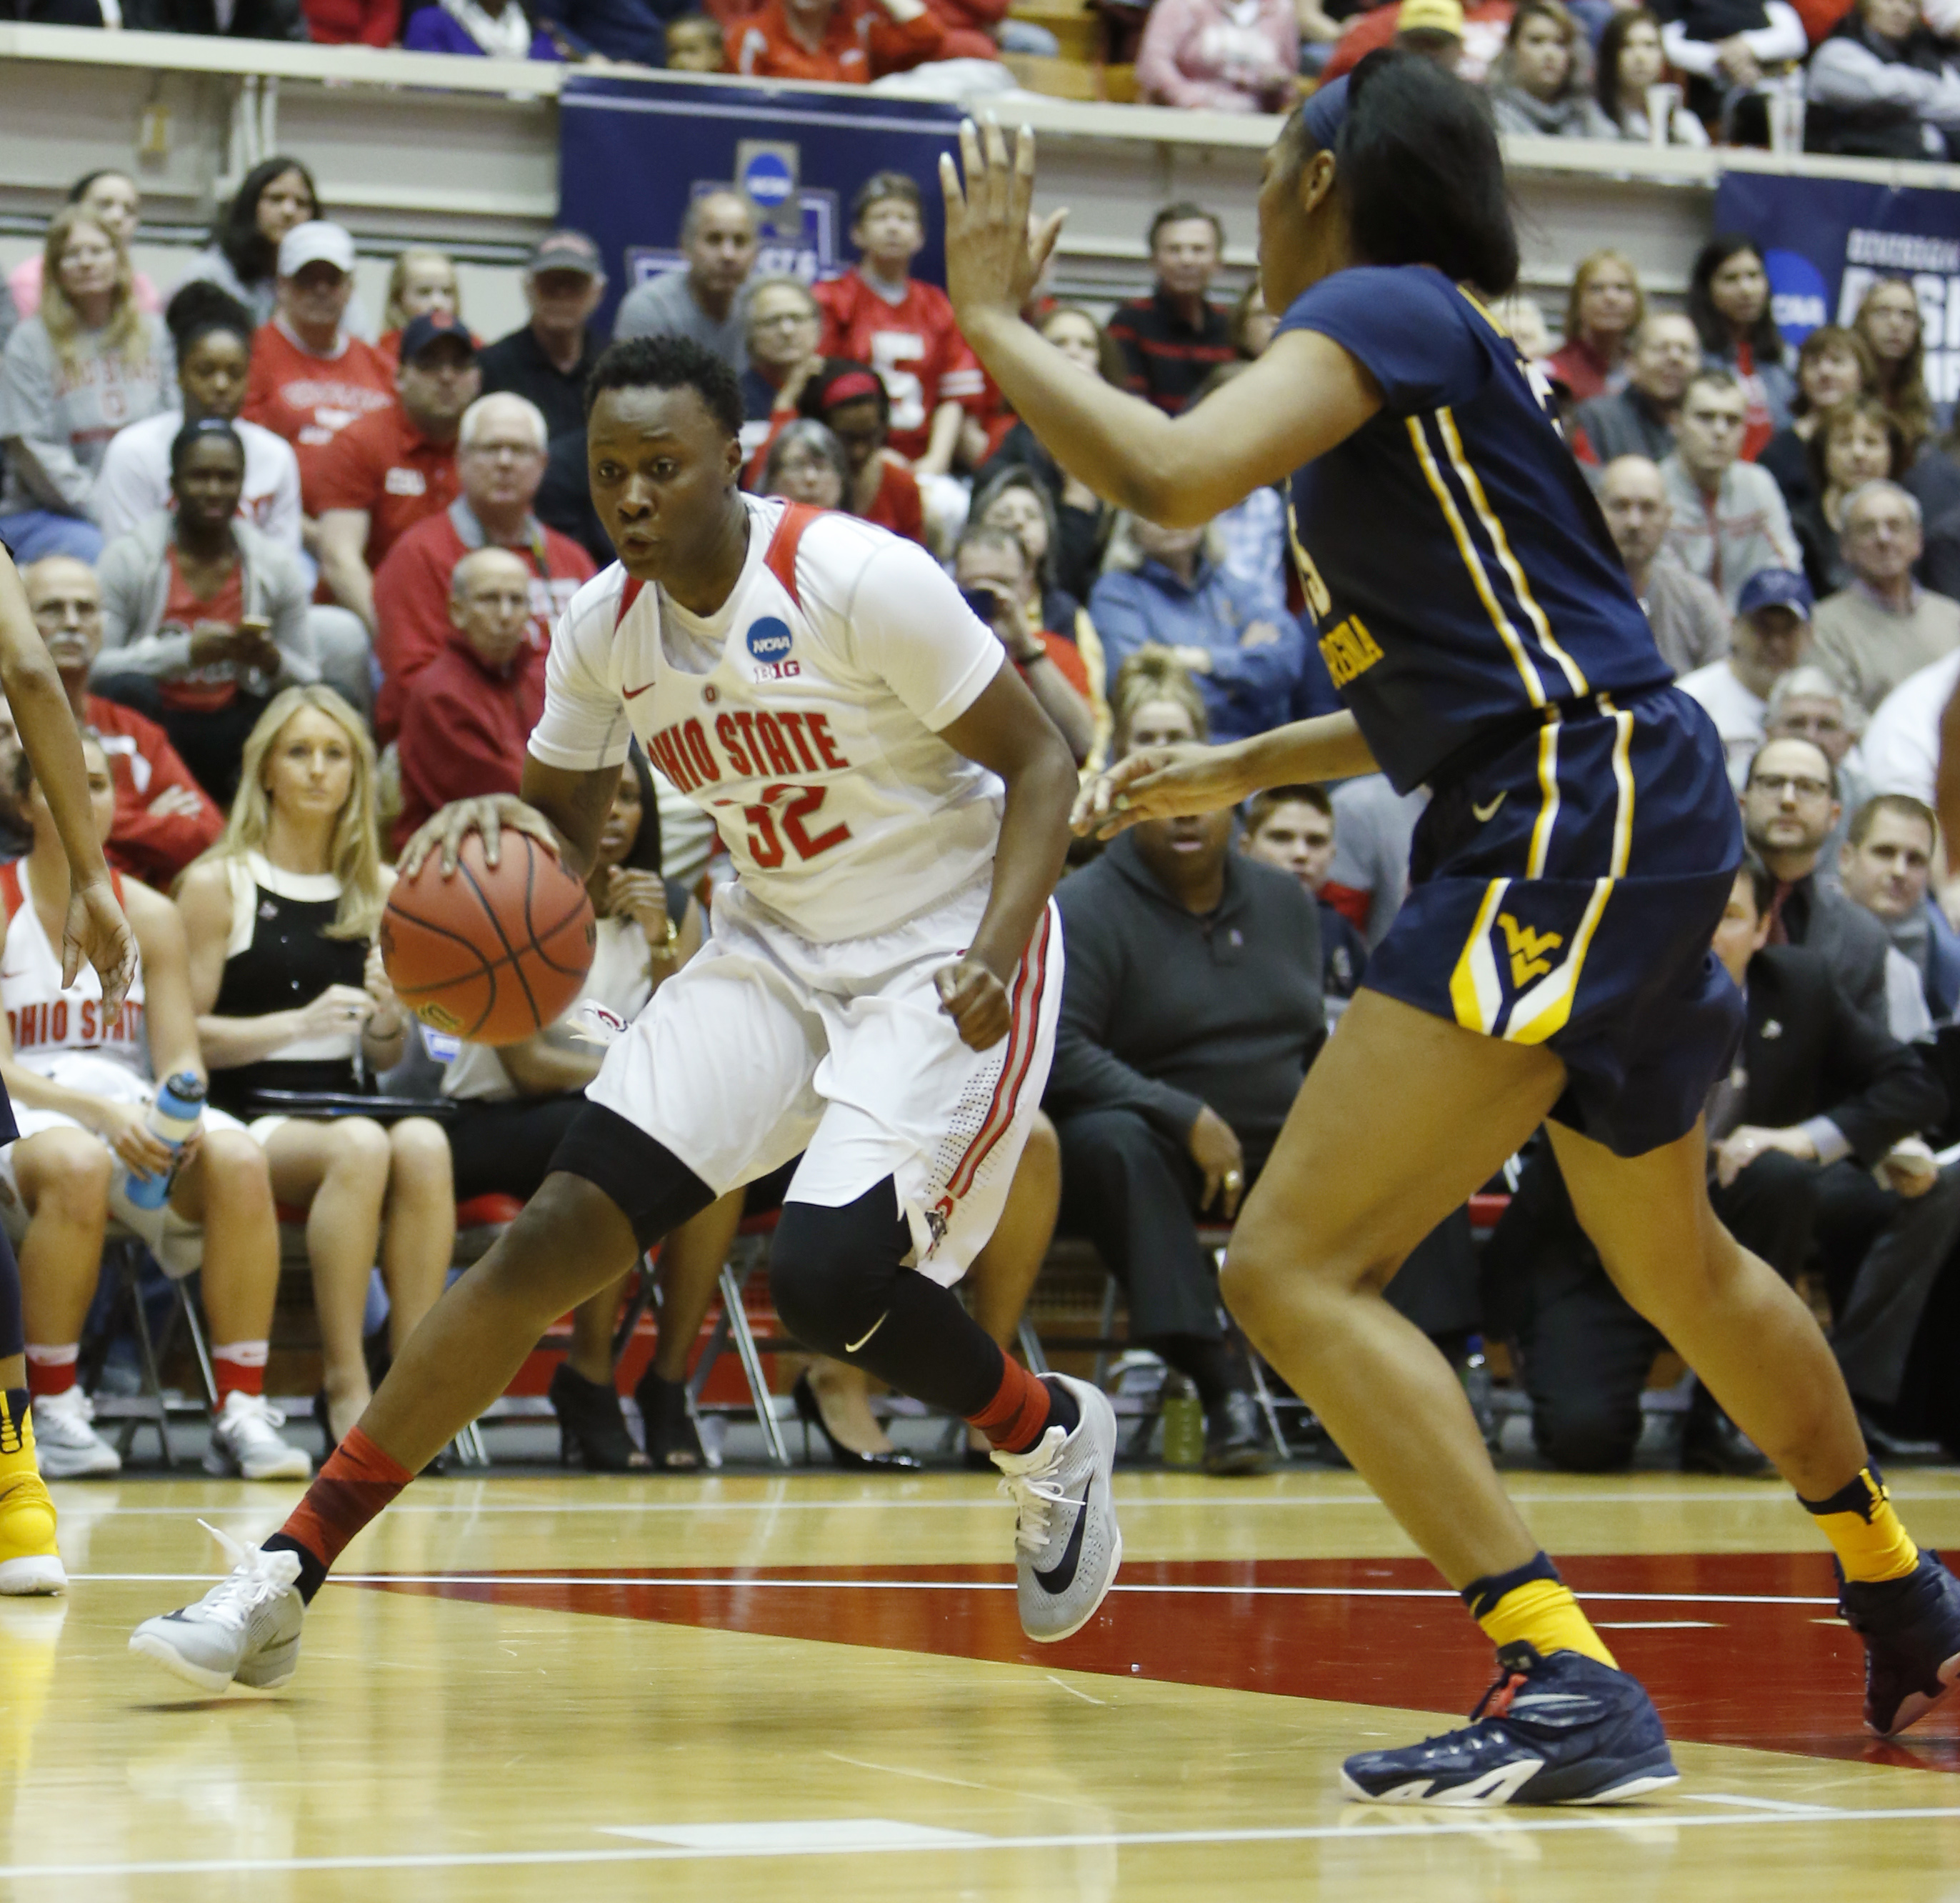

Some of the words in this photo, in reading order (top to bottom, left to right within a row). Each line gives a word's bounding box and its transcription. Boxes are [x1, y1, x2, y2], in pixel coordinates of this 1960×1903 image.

[873, 331, 925, 431] 5
[753, 635, 791, 654] NCAA
[715, 711, 850, 777] STATE
[712, 783, 853, 869] 32
